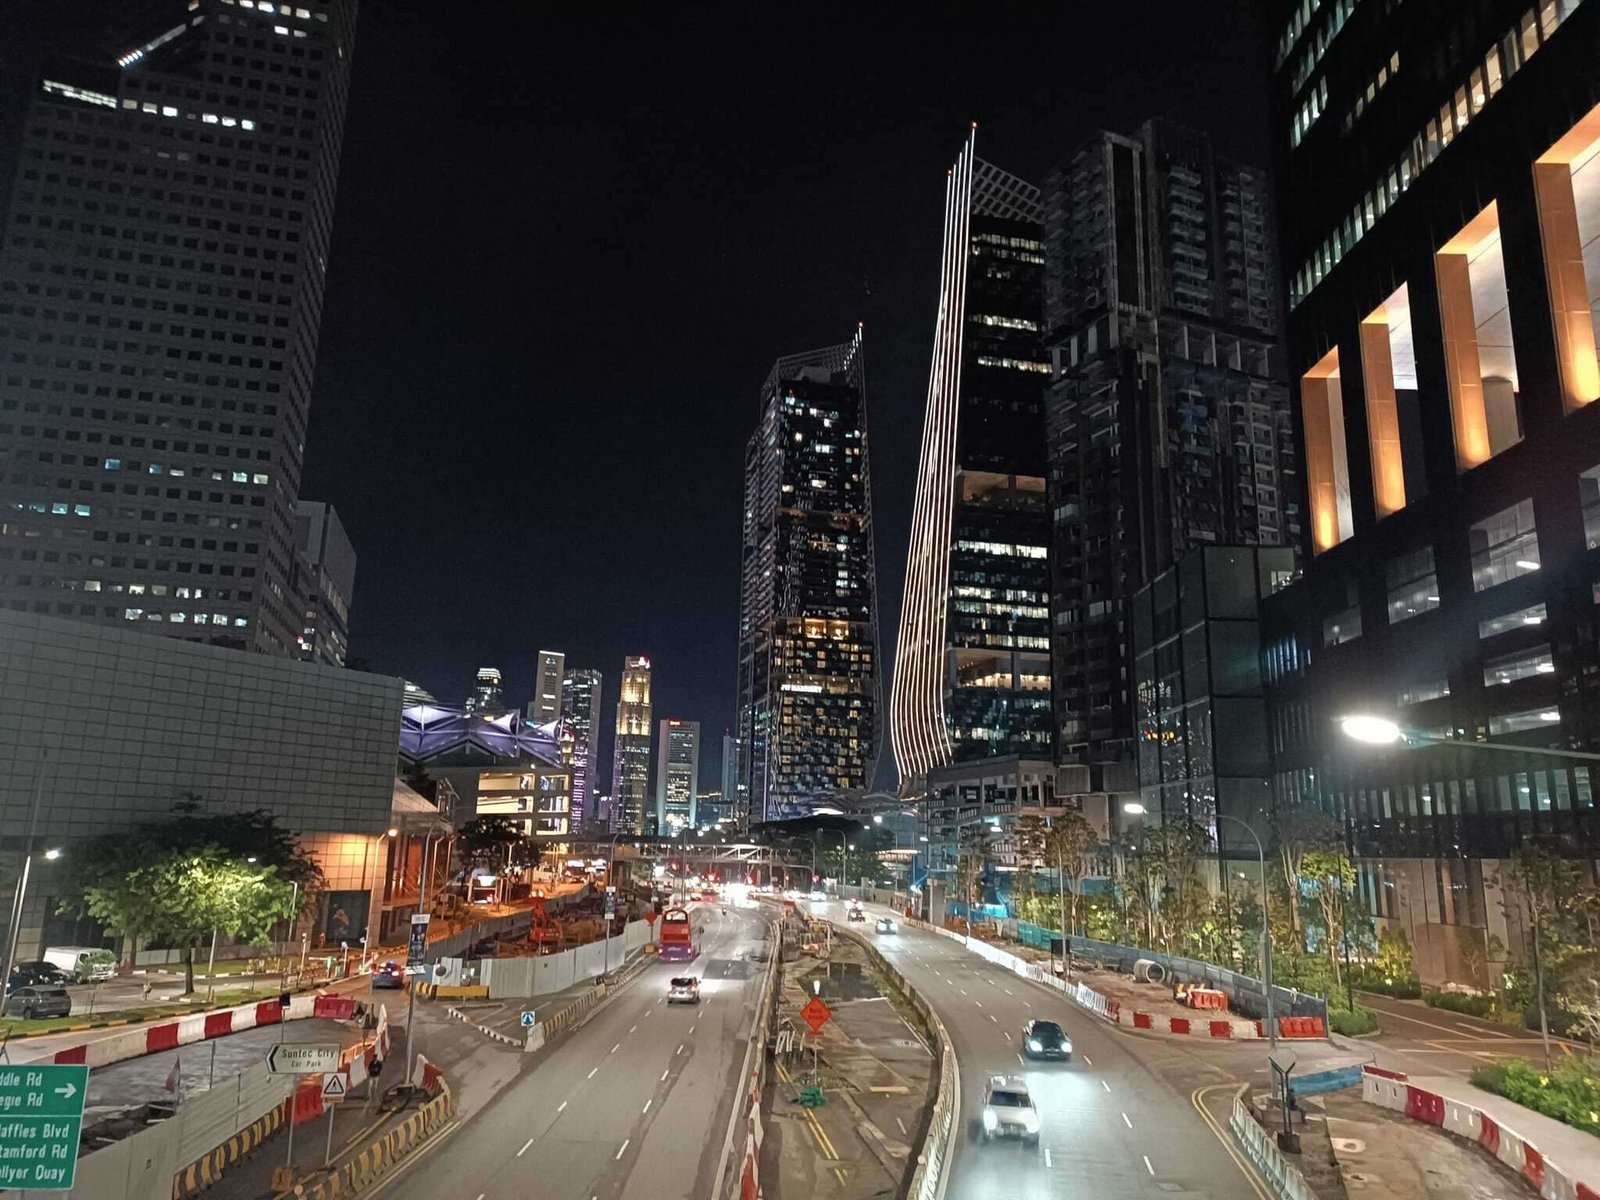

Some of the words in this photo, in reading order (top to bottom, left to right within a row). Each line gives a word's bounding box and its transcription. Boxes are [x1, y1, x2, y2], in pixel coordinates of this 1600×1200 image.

[282, 1048, 313, 1058] Suntec
[317, 1048, 335, 1059] City
[26, 1072, 43, 1086] Rd
[27, 1092, 44, 1106] Rd
[0, 1123, 36, 1138] affles
[42, 1123, 70, 1138] Blvd
[51, 1144, 68, 1158] Rd
[0, 1164, 29, 1183] llyer
[35, 1164, 66, 1183] Quay
